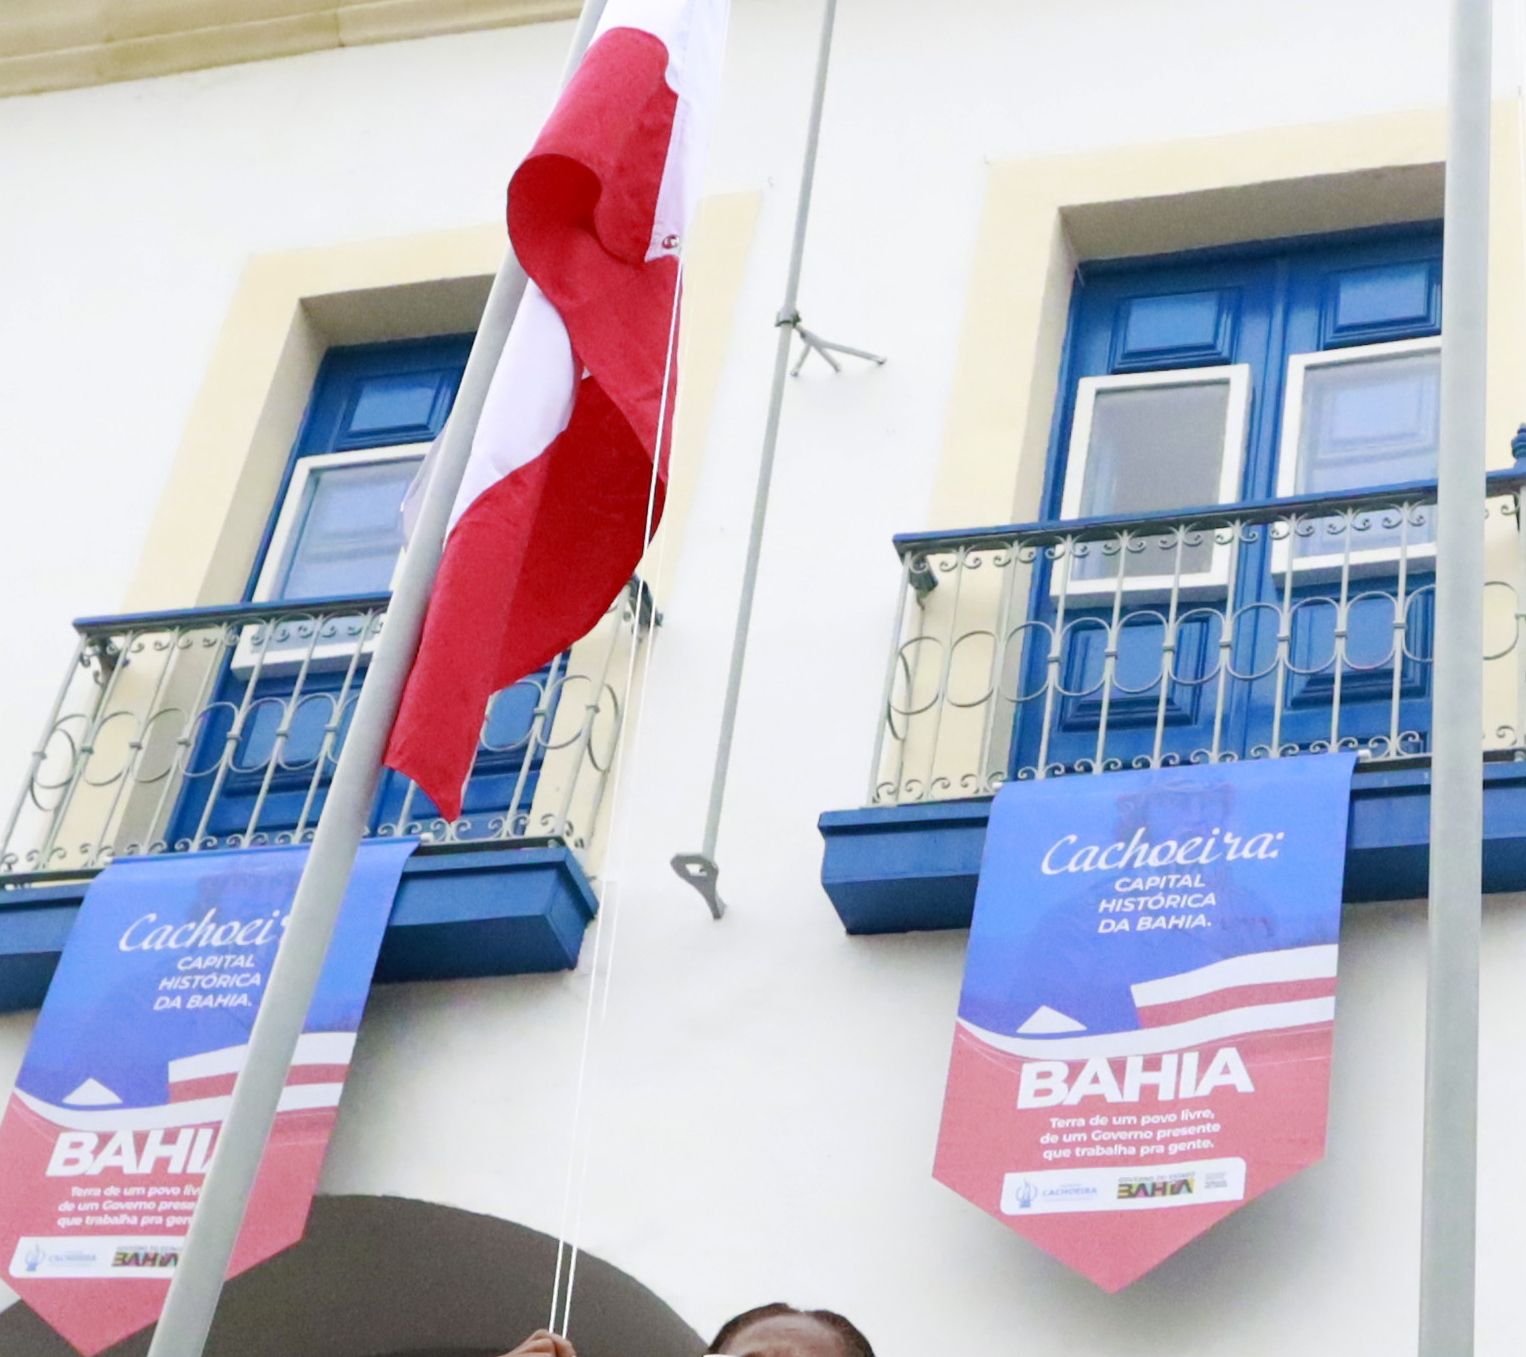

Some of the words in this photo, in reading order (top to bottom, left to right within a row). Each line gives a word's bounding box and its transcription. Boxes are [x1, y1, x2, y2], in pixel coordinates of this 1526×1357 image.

[1041, 827, 1285, 875] Cachoeira:
[1114, 874, 1206, 892] CAPITAL
[1098, 892, 1216, 913] HISTÓRICA
[119, 908, 290, 951] Cachoei
[1098, 919, 1130, 933] DA
[1136, 914, 1212, 931] BAHIA.
[177, 954, 255, 970] CAPITAL
[158, 972, 261, 991] HISTÓRICA
[153, 996, 181, 1011] DA
[186, 994, 252, 1009] BAHIA.
[1017, 1047, 1255, 1109] BAHIA
[1050, 1117, 1086, 1128] Terra
[1089, 1115, 1108, 1125] de
[1112, 1116, 1137, 1125] um
[1141, 1114, 1177, 1126] povo
[1181, 1109, 1215, 1120] livre,
[1040, 1133, 1059, 1144] de
[1063, 1133, 1087, 1142] um
[1091, 1130, 1153, 1141] Governo
[1157, 1122, 1221, 1141] presente
[45, 1128, 211, 1176] BAHI
[1043, 1149, 1071, 1161] que
[1075, 1144, 1136, 1157] trabalha
[1140, 1145, 1164, 1157] pra
[1169, 1139, 1214, 1155] gente.
[104, 1185, 120, 1196] de
[123, 1187, 145, 1196] um
[148, 1186, 180, 1197] povo
[58, 1201, 74, 1211] de
[78, 1202, 99, 1211] um
[102, 1200, 156, 1210] Governo
[57, 1217, 83, 1228] que
[140, 1216, 163, 1227] pra
